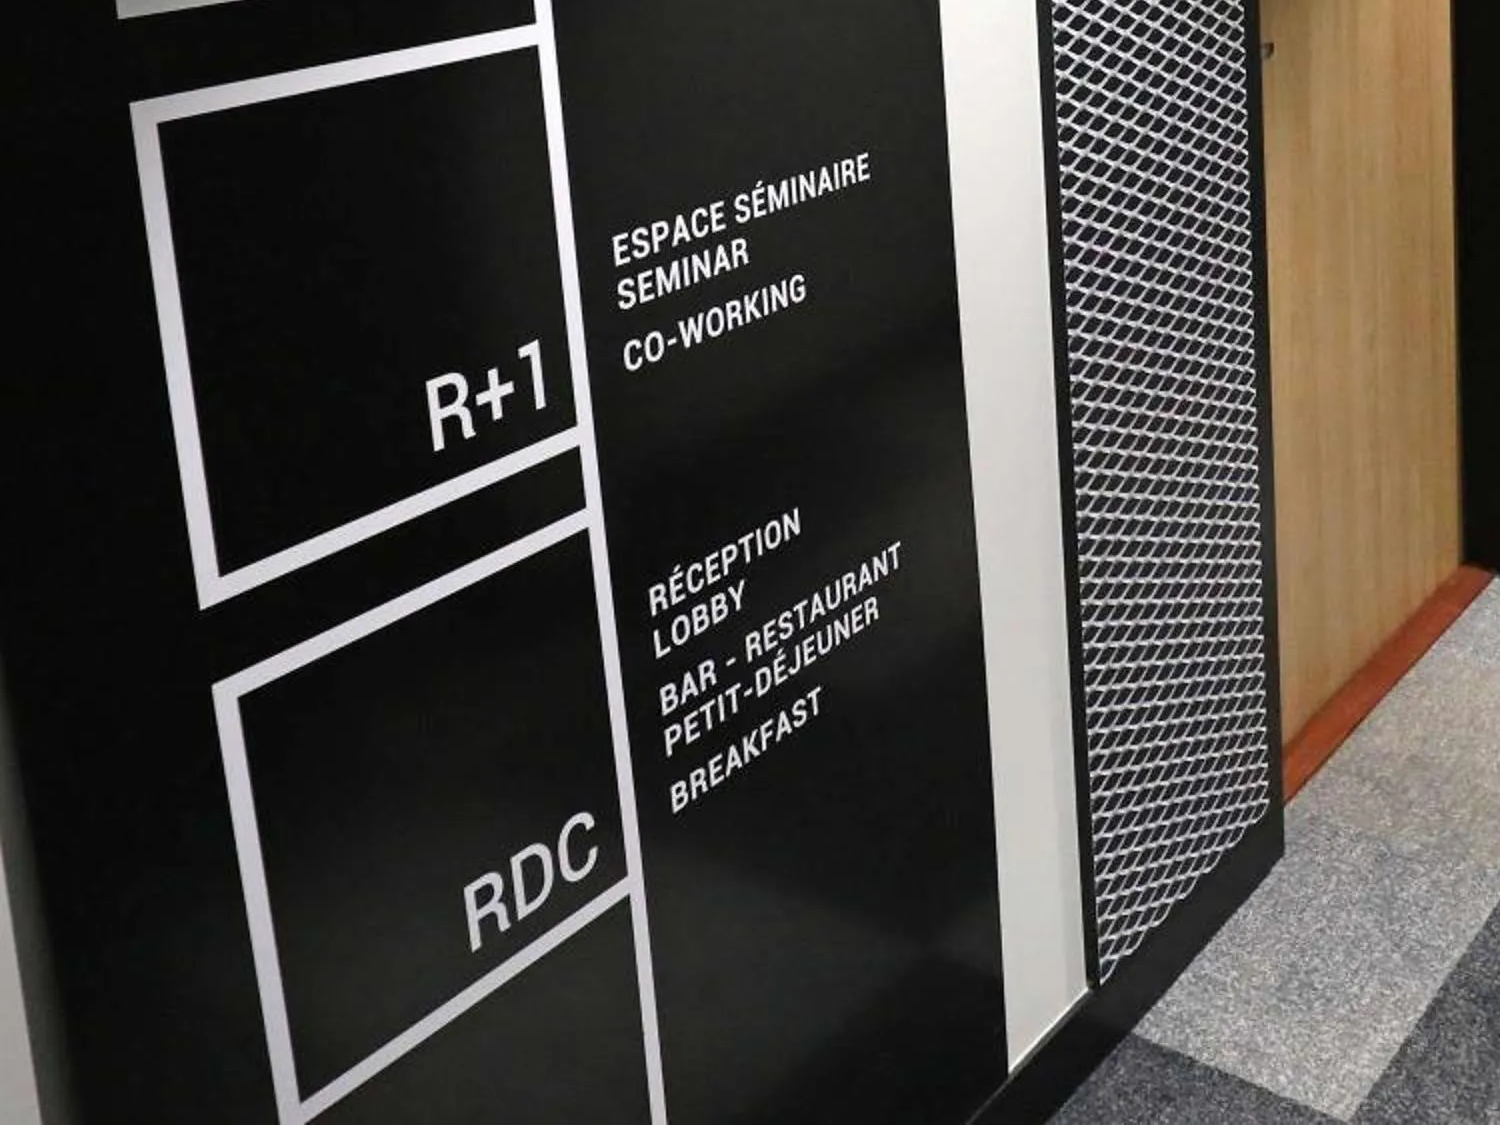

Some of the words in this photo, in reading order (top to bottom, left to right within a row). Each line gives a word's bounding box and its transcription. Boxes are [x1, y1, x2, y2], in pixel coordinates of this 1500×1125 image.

[612, 201, 726, 266] ESPACE
[735, 152, 870, 225] SÉMINAIRE
[616, 238, 750, 310] SEMINAR
[623, 274, 807, 371] CO-WORKING
[426, 339, 547, 451] R+1
[649, 508, 801, 616] RÉCEPTION
[653, 580, 747, 659] LOBBY
[659, 660, 717, 716] BAR
[745, 542, 901, 663] RESTAURANT
[664, 596, 880, 757] PETIT-DÉJEUNER
[671, 687, 823, 814] BREAKFAST
[463, 812, 599, 953] RDC
